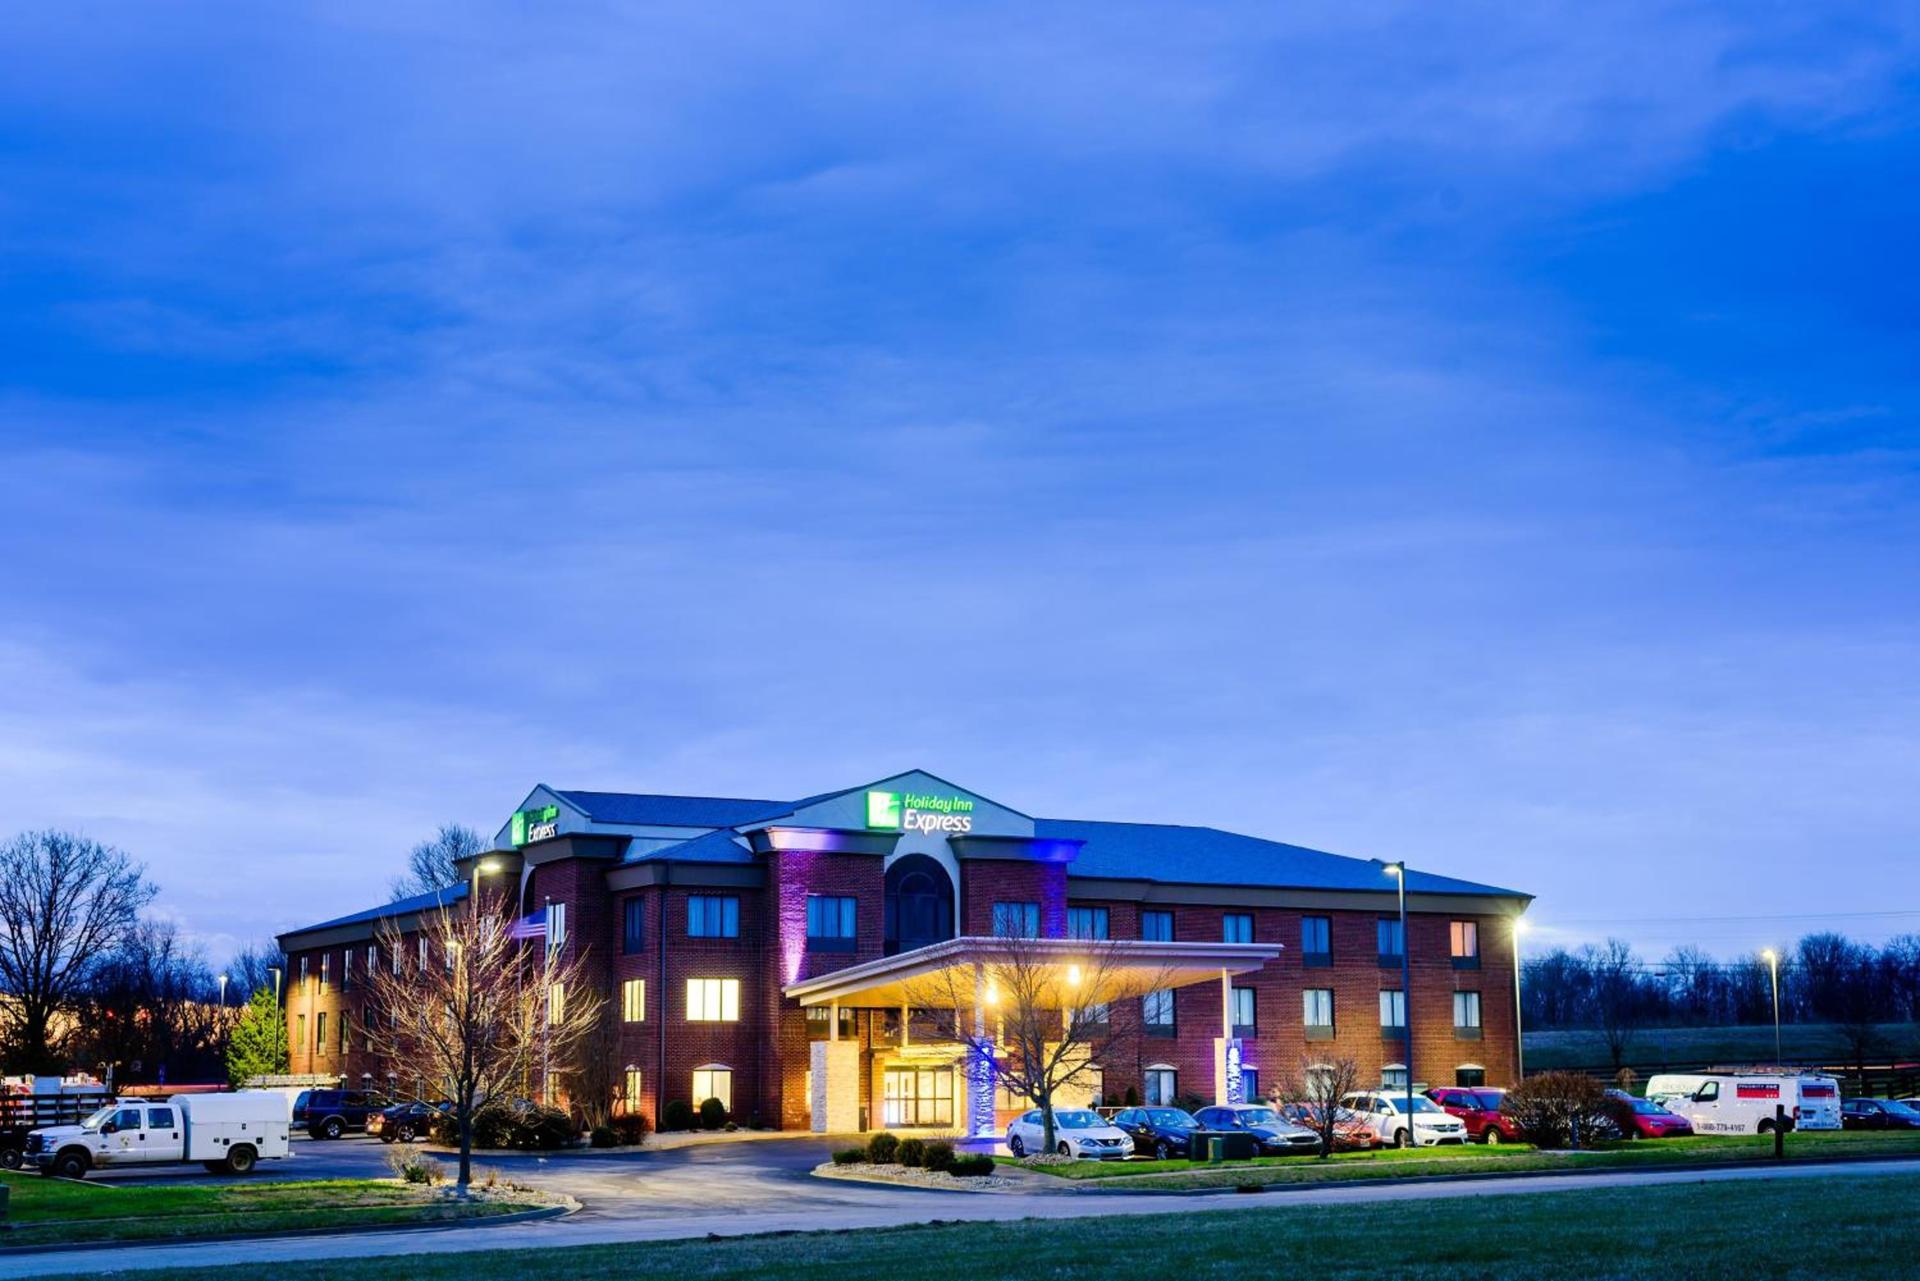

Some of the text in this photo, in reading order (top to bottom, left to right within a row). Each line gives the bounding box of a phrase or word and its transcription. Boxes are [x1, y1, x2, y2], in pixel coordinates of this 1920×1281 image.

[904, 793, 974, 813] Holiday Inn
[903, 808, 972, 835] Express
